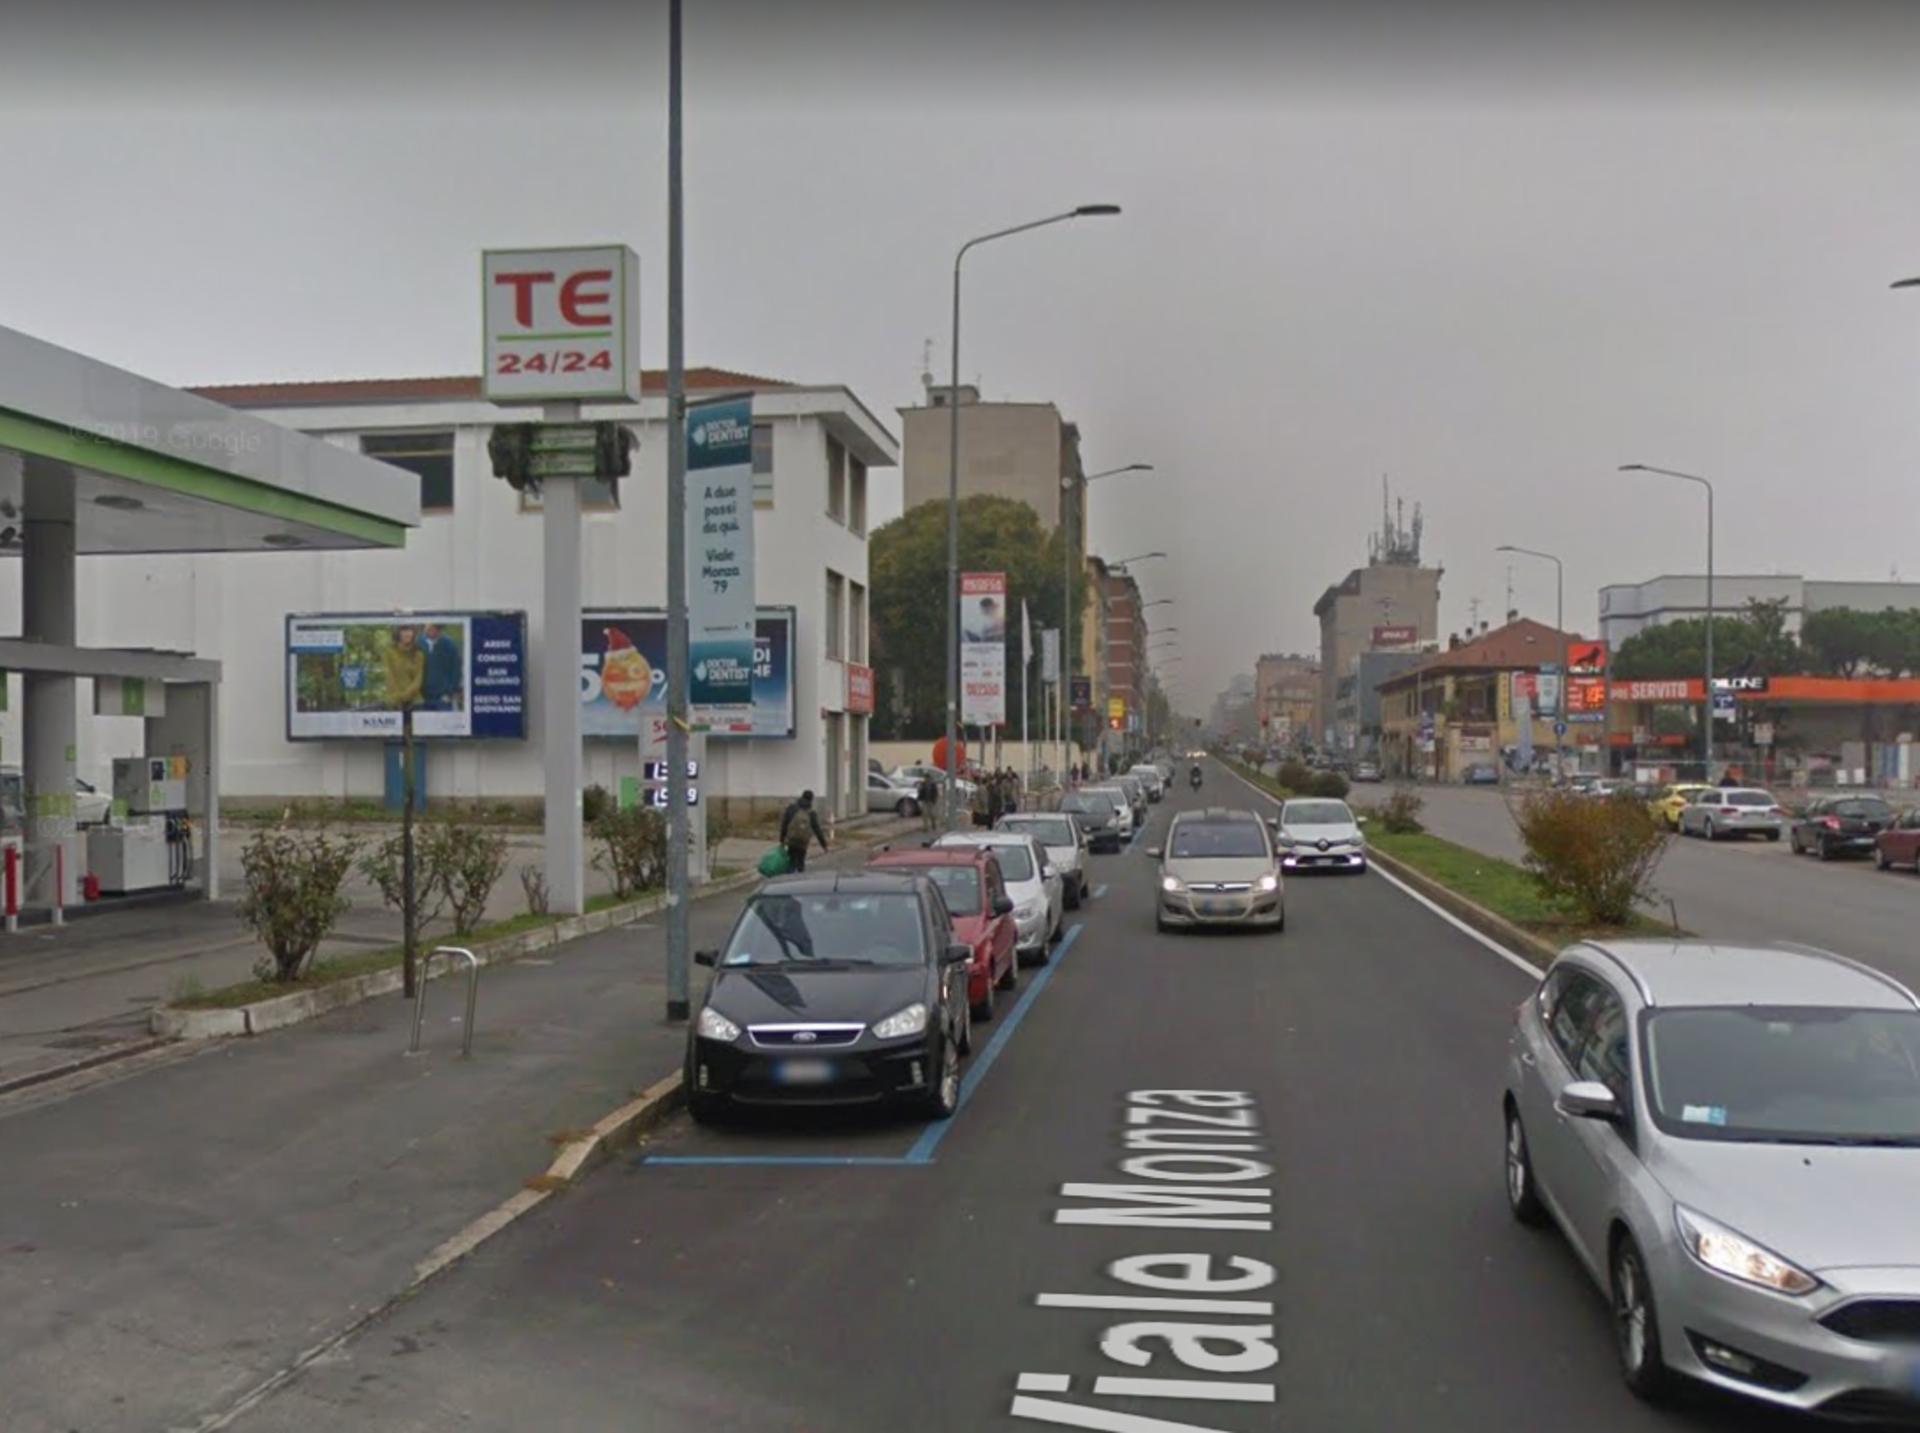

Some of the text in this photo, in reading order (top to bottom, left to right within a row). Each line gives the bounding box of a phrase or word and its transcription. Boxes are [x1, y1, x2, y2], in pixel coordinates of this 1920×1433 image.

[494, 269, 613, 329] TE
[497, 350, 612, 375] 24/24
[714, 485, 736, 498] due
[706, 548, 734, 562] Viale
[702, 566, 740, 578] Monza
[713, 580, 728, 594] 79
[708, 667, 750, 681] DENTIST
[1631, 681, 1687, 699] SERVITO
